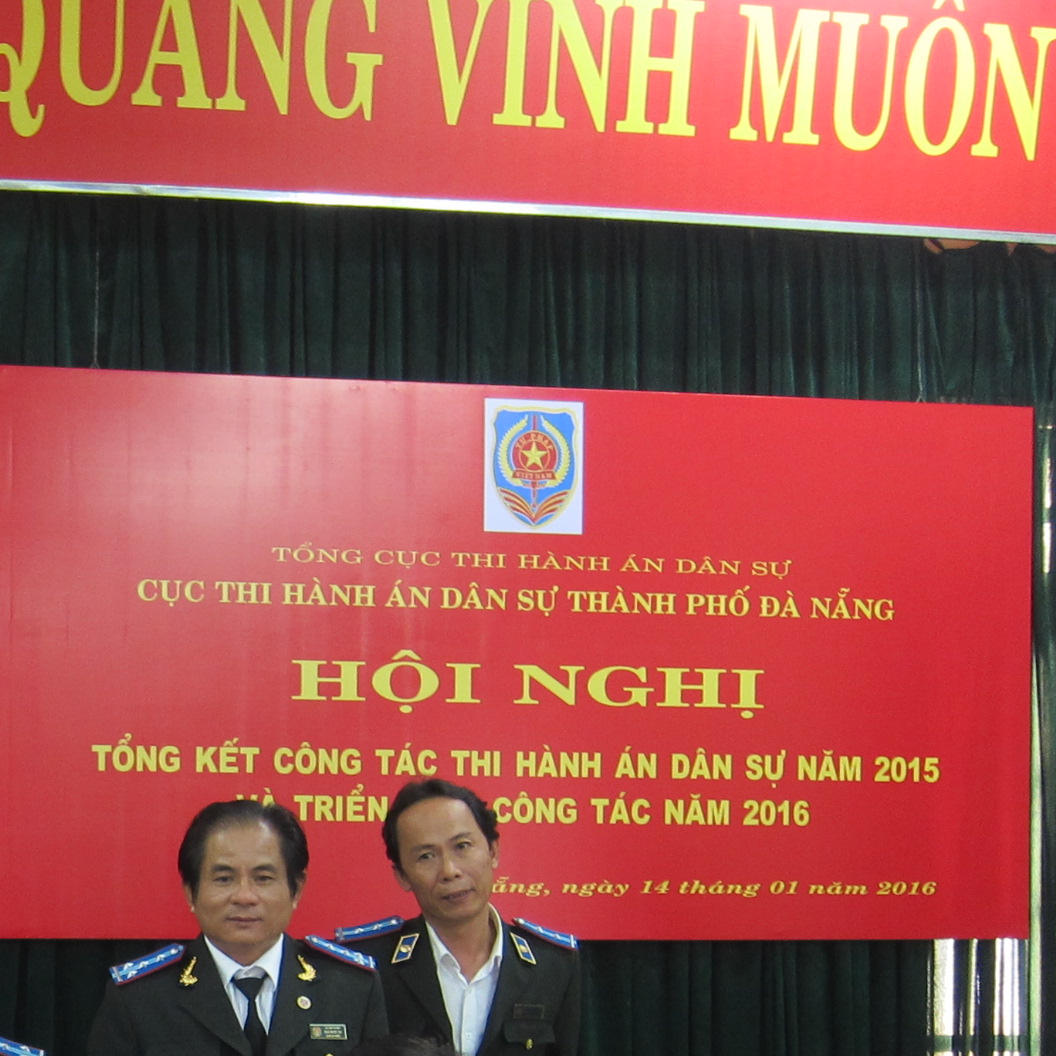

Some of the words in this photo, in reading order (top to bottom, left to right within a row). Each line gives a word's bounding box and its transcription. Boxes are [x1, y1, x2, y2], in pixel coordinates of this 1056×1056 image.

[427, 0, 708, 137] VINH
[729, 0, 1056, 161] MUÔN
[271, 541, 363, 565] TỔNG
[374, 549, 441, 569] CỤC
[451, 552, 507, 569] THI
[518, 550, 610, 572] HÀNH
[620, 553, 665, 573] ÁN
[675, 556, 742, 576] DÂN
[751, 559, 793, 580] SỰ
[137, 578, 205, 607] CỤC
[215, 580, 272, 605] THI
[282, 576, 377, 608] HÀNH
[385, 579, 432, 609] ÁN
[440, 582, 509, 611] DÂN
[517, 585, 560, 617] SỰ
[567, 585, 677, 616] THÀNH
[686, 584, 751, 617] PHỐ
[760, 590, 801, 619] ĐÀ
[810, 587, 895, 621] NẴNG
[290, 649, 482, 714] HỘI
[513, 664, 766, 720] NGHỊ
[92, 732, 181, 773] TỔNG
[195, 737, 260, 775] KẾT
[274, 741, 362, 776] CÔNG
[374, 743, 438, 777] TÁC
[450, 749, 501, 777] THI
[516, 744, 602, 779] HÀNH
[614, 745, 657, 779] ÁN
[671, 747, 733, 780] DÂN
[745, 749, 787, 789] SỰ
[797, 749, 862, 782] NĂM
[874, 756, 941, 783] 2015
[293, 783, 389, 822] TRIỂN
[492, 790, 579, 825] CÔNG
[590, 792, 651, 825] TÁC
[664, 793, 731, 826] NĂM
[742, 799, 811, 827] 2016
[561, 879, 630, 898] ngày
[642, 880, 670, 895] 14
[678, 879, 761, 899] tháng
[769, 881, 799, 895] 01
[808, 881, 868, 896] năm
[876, 881, 936, 896] 2016
